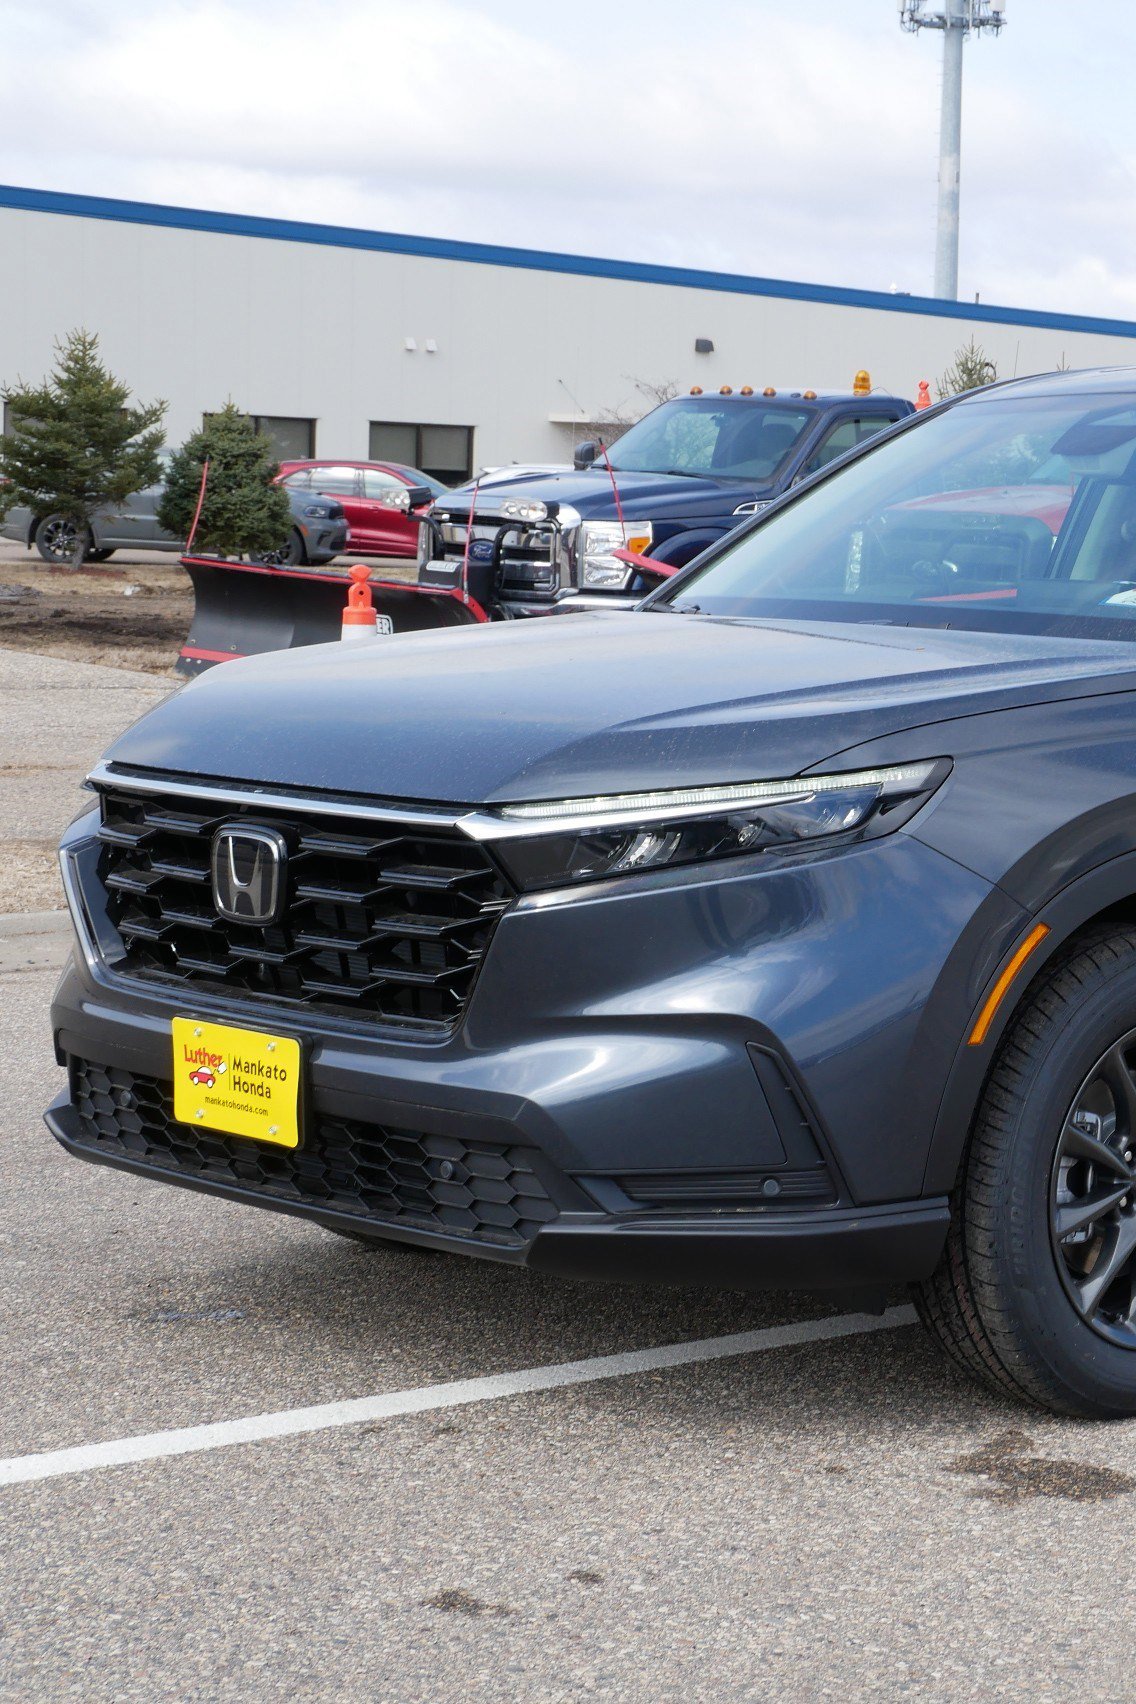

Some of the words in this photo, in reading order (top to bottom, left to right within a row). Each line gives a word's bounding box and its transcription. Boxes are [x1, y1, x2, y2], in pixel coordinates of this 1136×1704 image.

[474, 544, 492, 558] Ford
[184, 1044, 223, 1068] Luther
[232, 1056, 287, 1082] Mankato
[233, 1075, 271, 1099] Honda
[205, 1096, 269, 1116] mankatohonda.com
